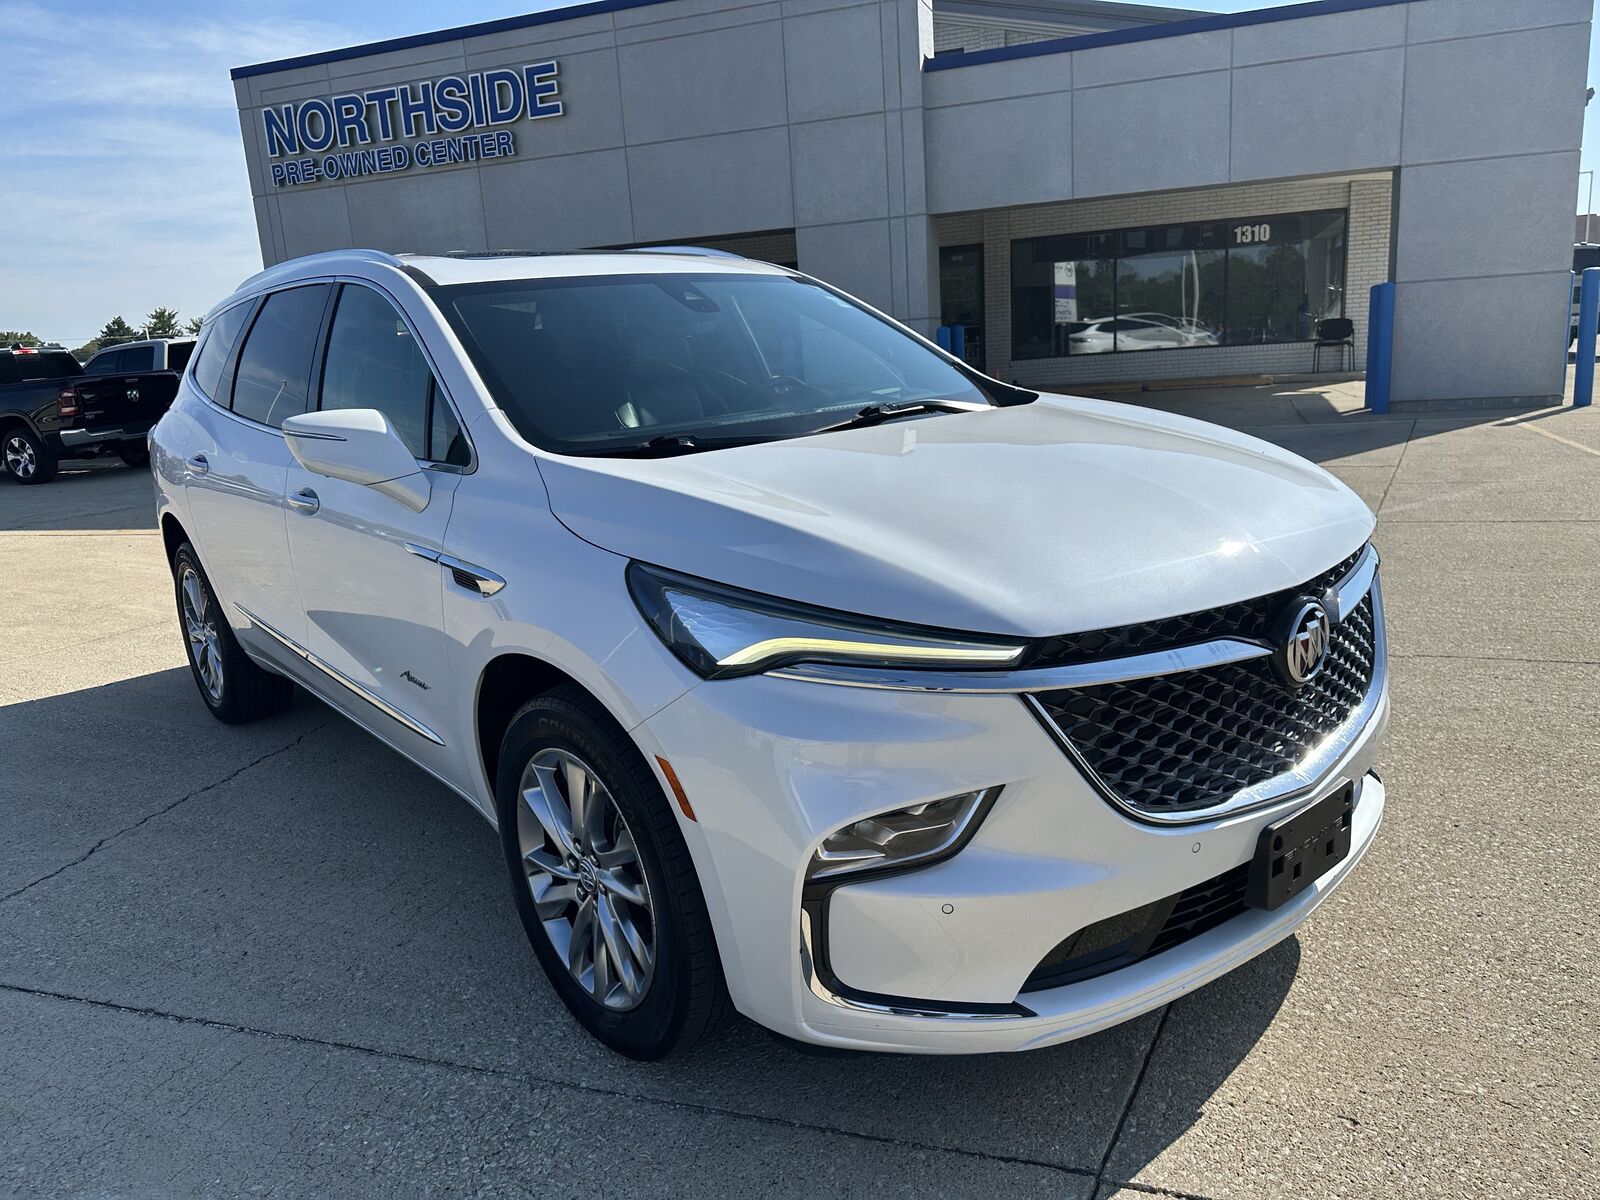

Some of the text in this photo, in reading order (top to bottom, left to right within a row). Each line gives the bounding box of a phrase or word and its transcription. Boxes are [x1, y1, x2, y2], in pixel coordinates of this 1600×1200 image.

[262, 60, 563, 158] NORTHSIDE
[271, 130, 515, 187] PRE-OWNED CENTER
[1233, 224, 1271, 244] 1310
